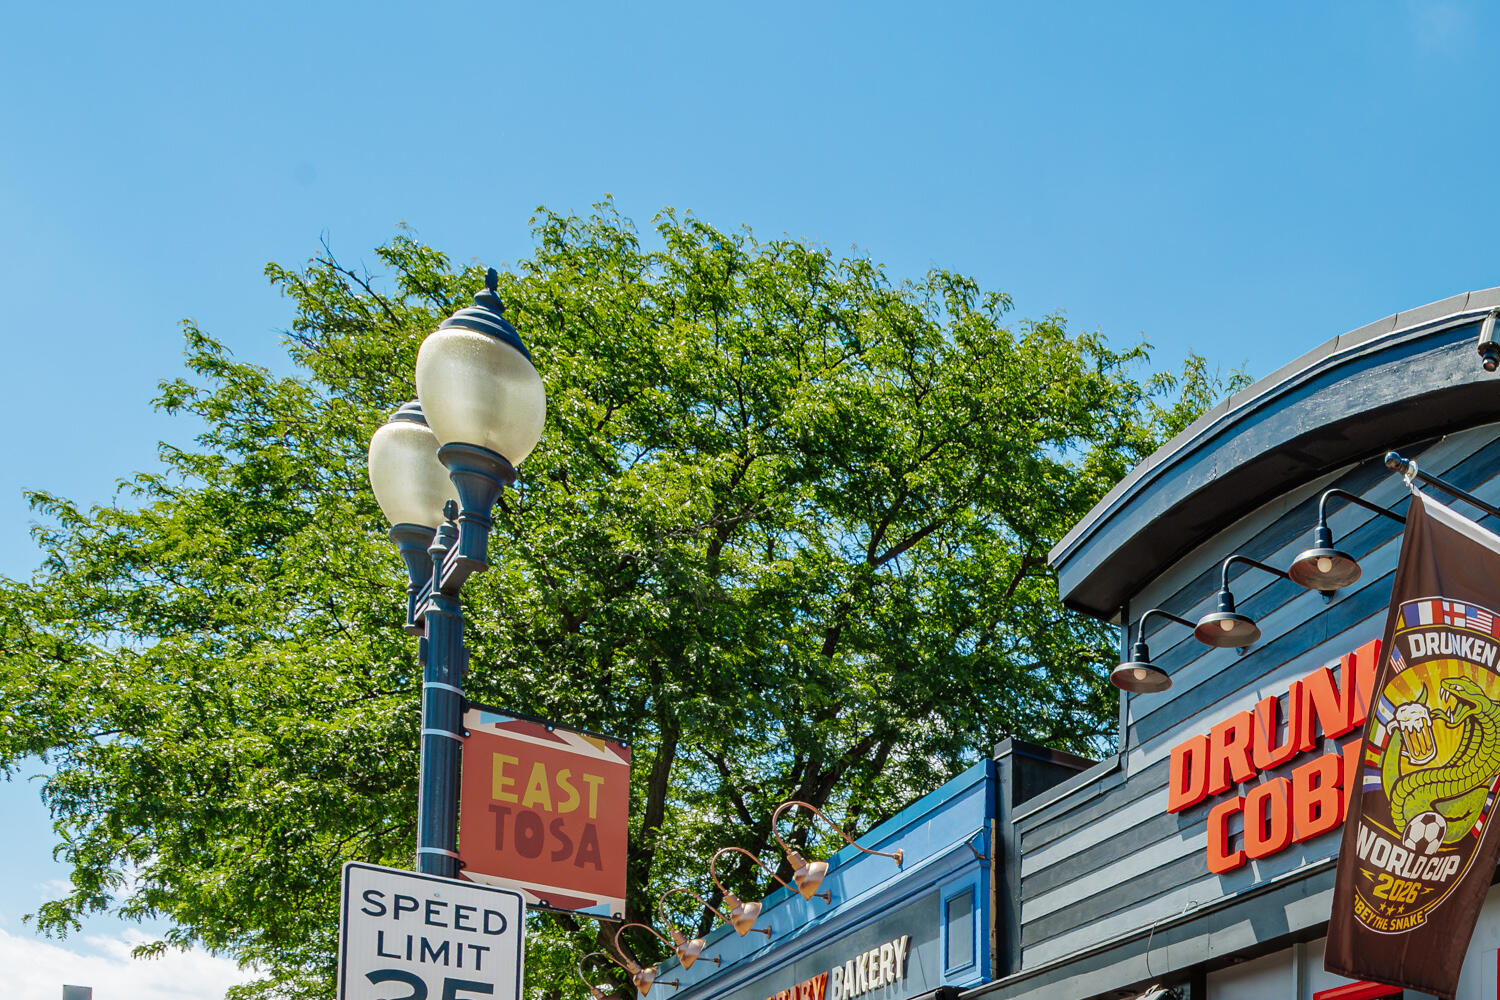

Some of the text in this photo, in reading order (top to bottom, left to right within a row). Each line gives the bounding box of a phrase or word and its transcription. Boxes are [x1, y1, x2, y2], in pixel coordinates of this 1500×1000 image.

[1408, 631, 1498, 668] DRUNKEN
[491, 751, 605, 820] EAST
[487, 803, 604, 872] TOSA
[1355, 819, 1461, 882] WORLD CUP
[1372, 872, 1422, 904] 2026
[361, 888, 508, 936] SPEED
[1373, 914, 1389, 931] THE
[1389, 910, 1425, 931] SNAKE
[376, 929, 490, 972] LIMIT
